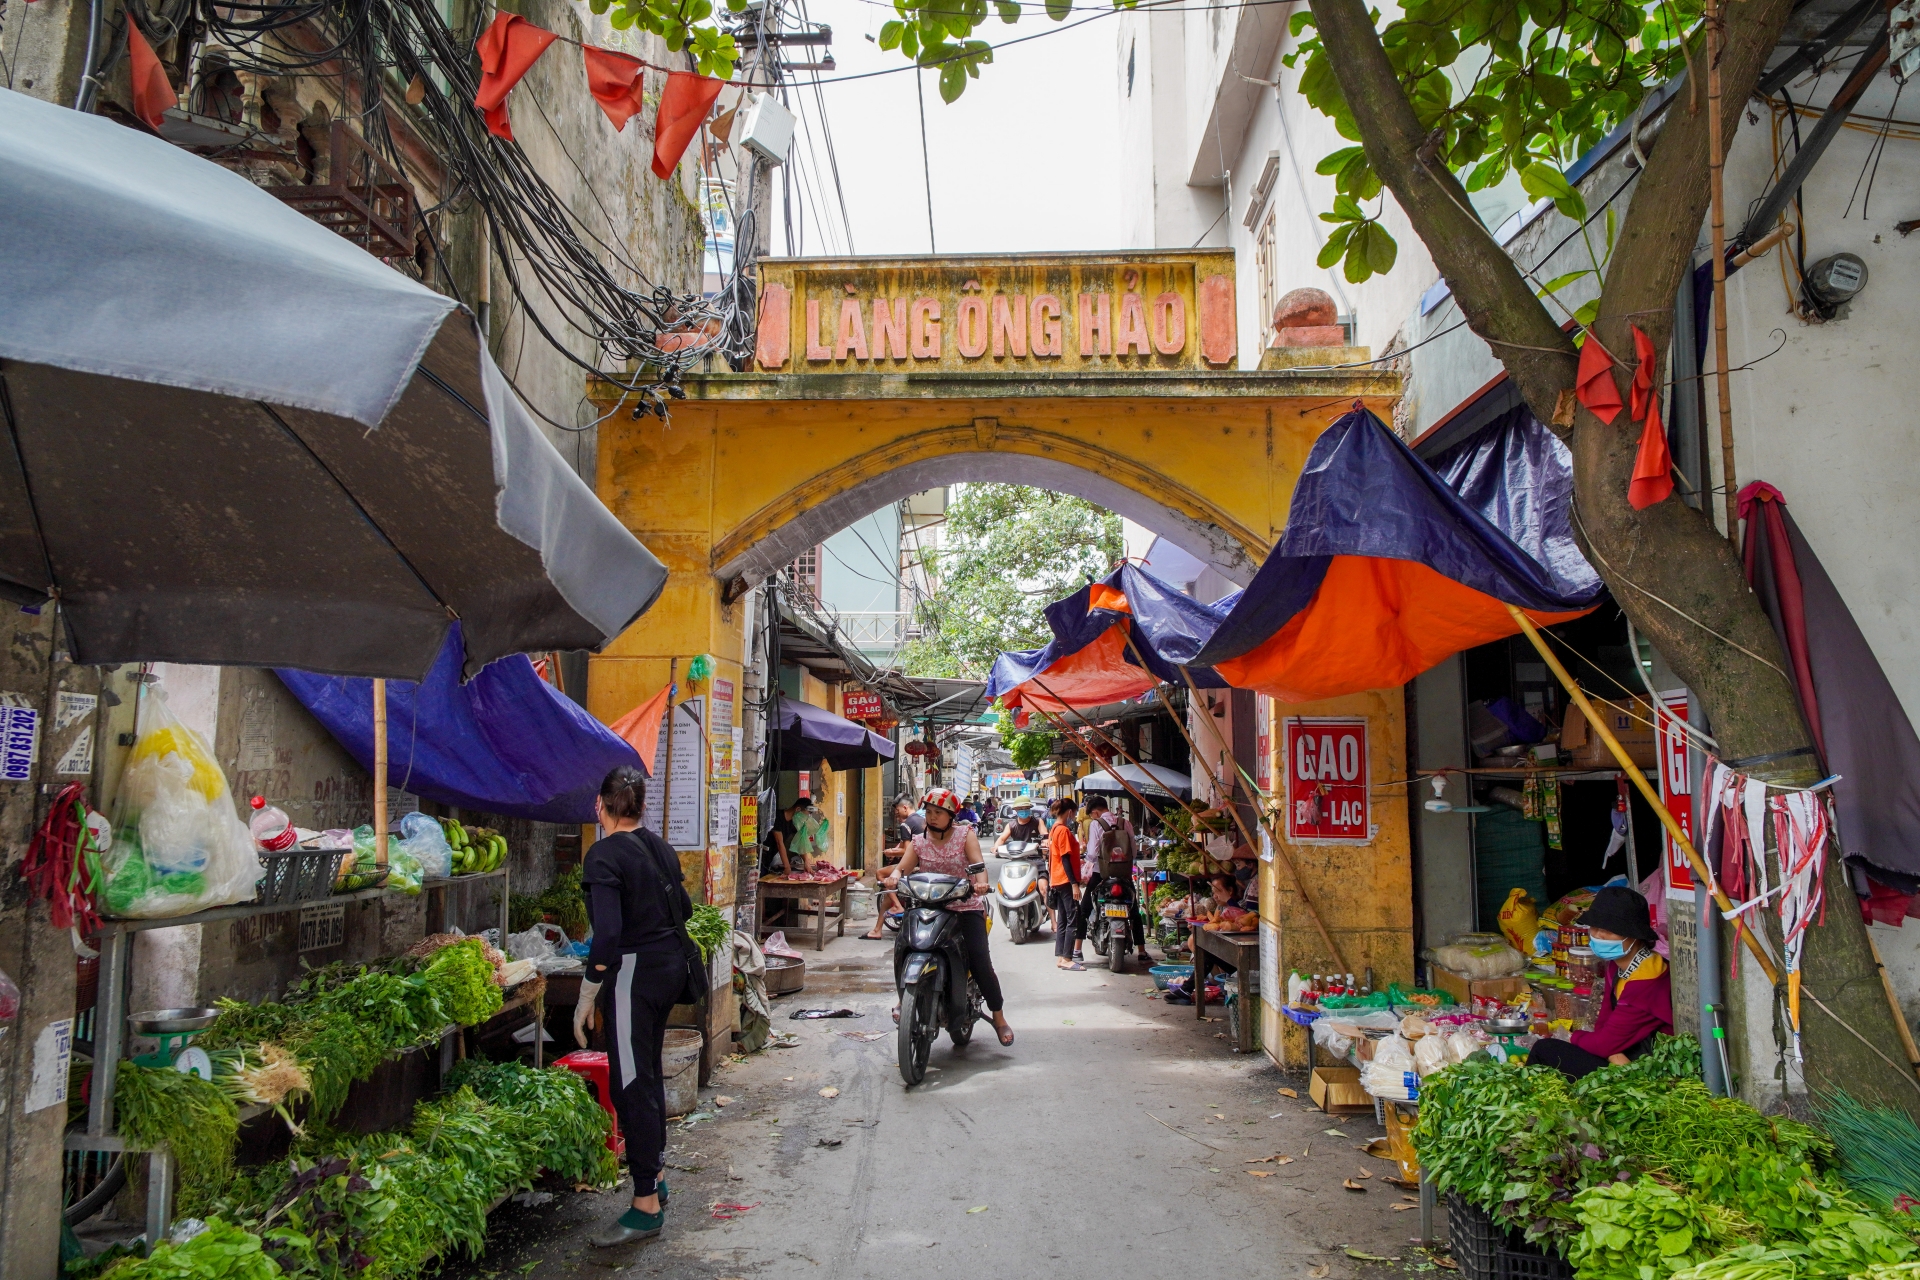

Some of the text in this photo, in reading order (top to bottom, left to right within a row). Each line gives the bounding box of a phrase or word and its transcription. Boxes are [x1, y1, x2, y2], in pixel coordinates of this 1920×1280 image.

[806, 270, 1186, 361] LÀNG ÔNG HẢO
[5, 710, 36, 778] 0987.831.202
[742, 796, 758, 807] TAX
[1331, 800, 1362, 831] LẠC
